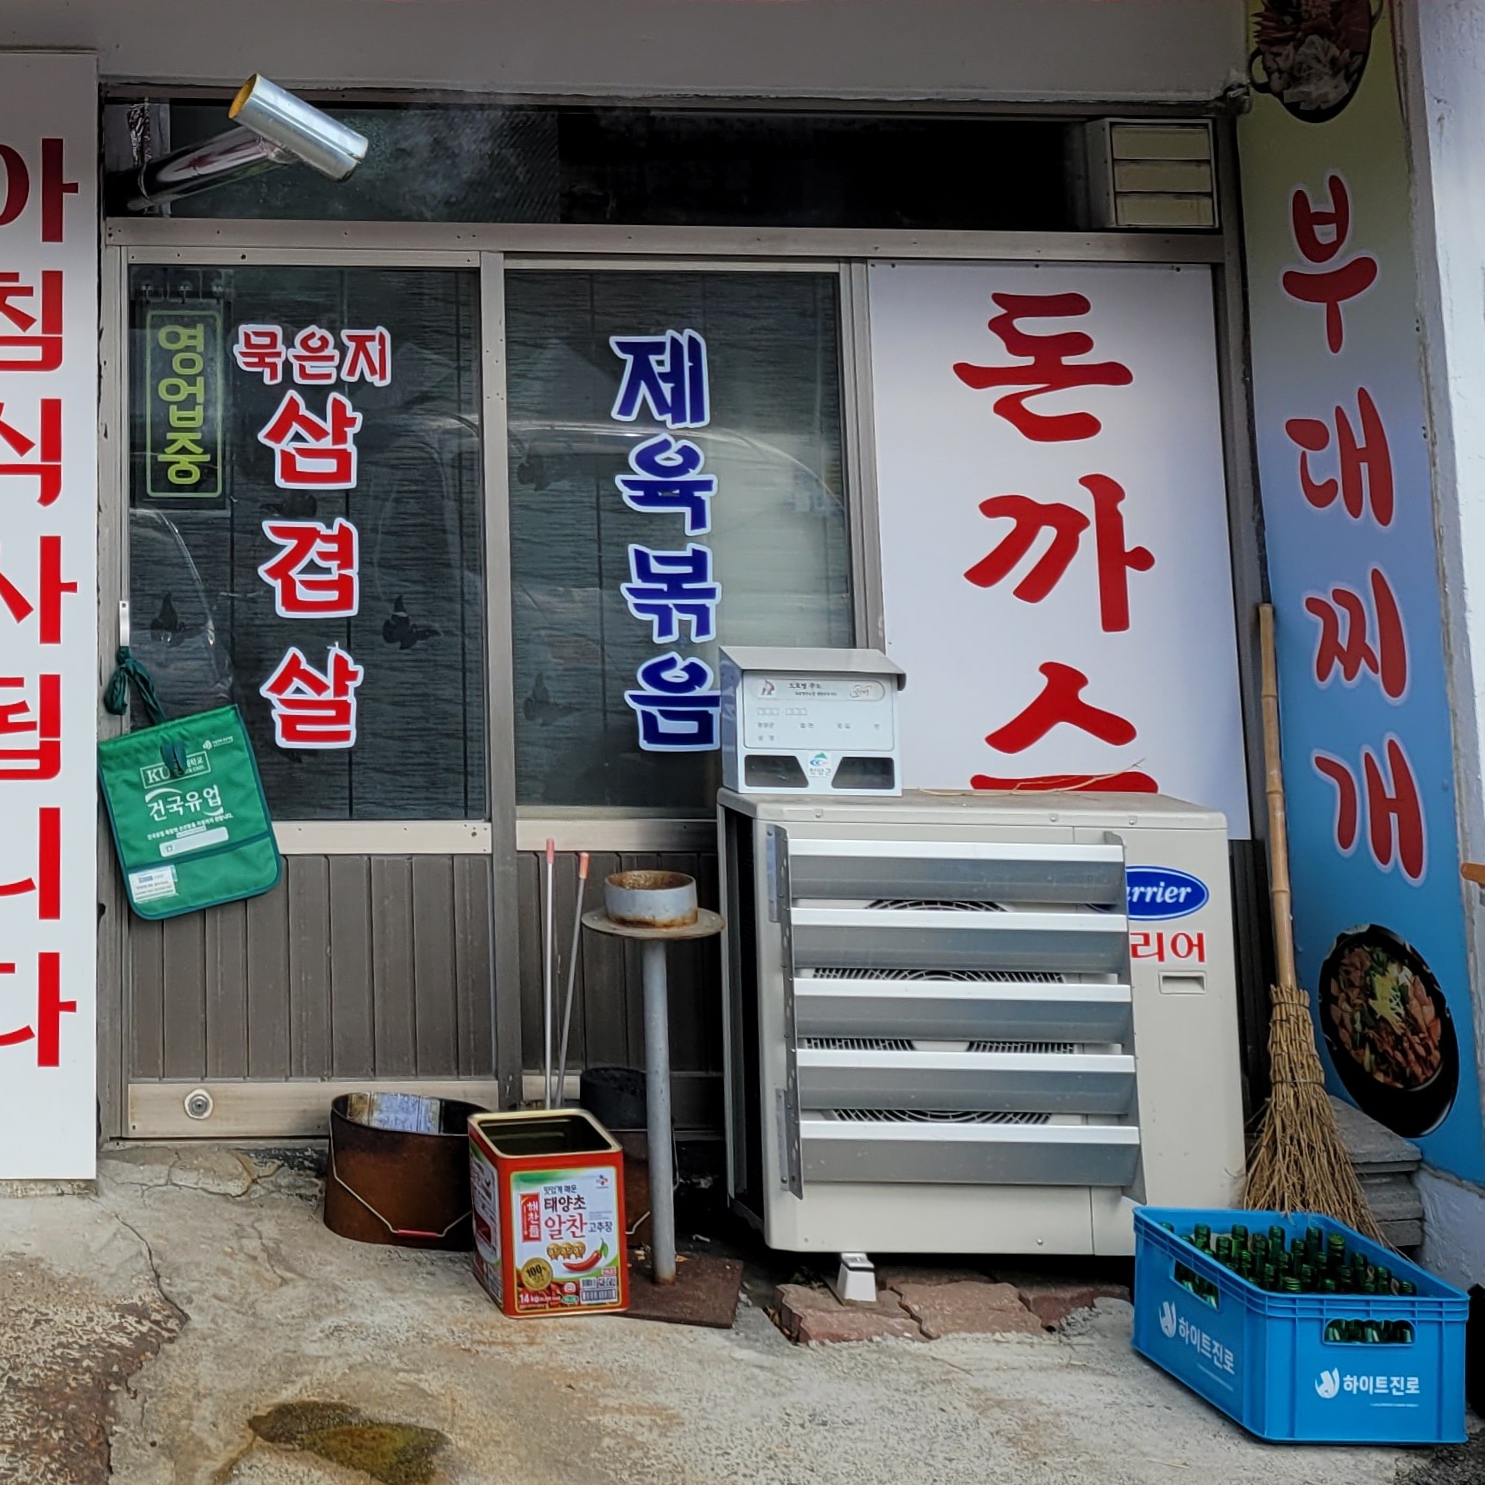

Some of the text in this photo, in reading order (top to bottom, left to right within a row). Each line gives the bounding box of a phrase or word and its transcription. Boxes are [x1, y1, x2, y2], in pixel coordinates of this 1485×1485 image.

[233, 323, 392, 387] 묵은지
[157, 322, 211, 485] 영업중
[608, 328, 721, 752] 제육볶음
[952, 291, 1159, 794] 돈까스
[1281, 174, 1424, 881] 부대찌개
[257, 389, 365, 750] 삼겹살
[147, 784, 222, 822] 건국유업
[1126, 881, 1192, 903] rrier
[1129, 931, 1206, 963] 리어
[544, 1194, 587, 1213] 태양초
[544, 1213, 588, 1240] 알찬
[588, 1221, 613, 1233] 고추장
[1178, 1316, 1236, 1375] 하이트진로
[1342, 1374, 1421, 1396] 하이트진로
